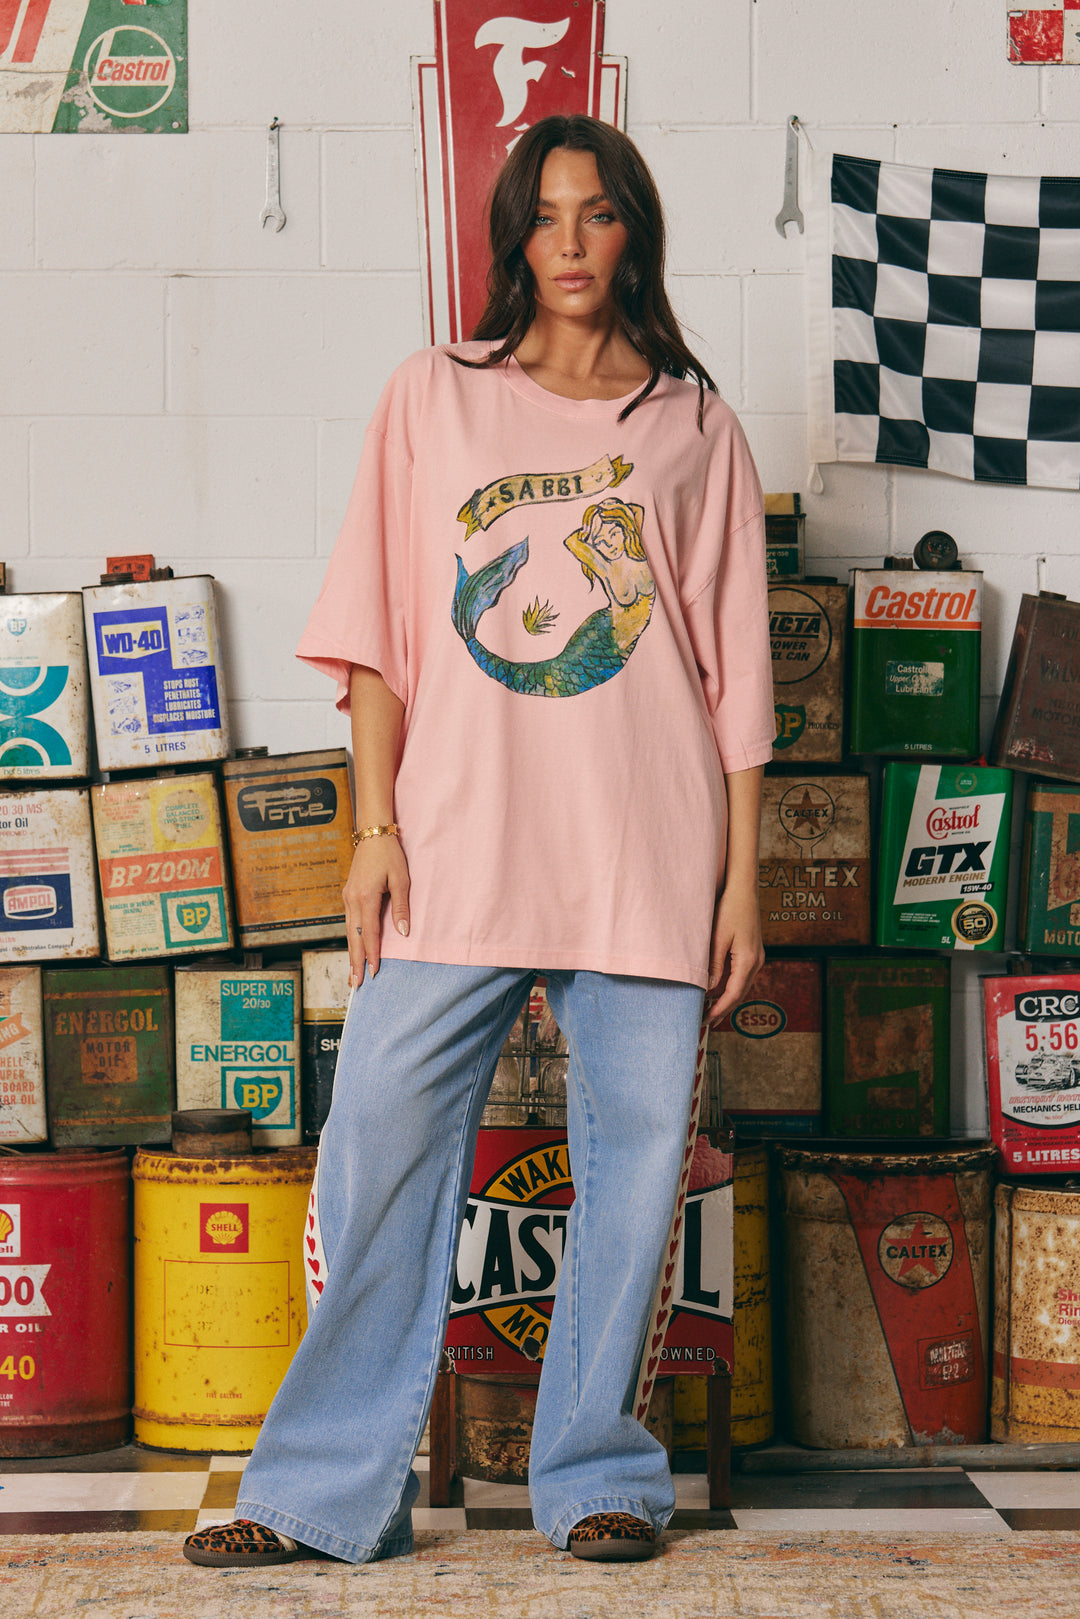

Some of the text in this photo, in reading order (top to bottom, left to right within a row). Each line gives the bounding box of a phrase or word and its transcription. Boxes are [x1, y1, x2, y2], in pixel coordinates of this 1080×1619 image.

[97, 59, 170, 82] Castrol
[499, 475, 583, 503] SABBI
[864, 585, 977, 621] Castrol
[786, 651, 810, 661] CAN
[163, 678, 199, 690] STOPS RUST
[164, 689, 201, 700] PENETRATES
[165, 699, 202, 711] LUBRICATES
[153, 709, 216, 723] DISPLACES MOISTURE
[145, 741, 186, 753] 5 LITRES
[11, 805, 23, 815] 30
[26, 804, 43, 814] MS
[785, 808, 829, 818] CALTEX
[15, 817, 29, 828] Oil
[926, 805, 981, 840] Castrol
[905, 841, 992, 877] GTX
[108, 856, 214, 889] BP ZOOM
[759, 866, 860, 888] CALTEX
[903, 871, 986, 888] MODERN ENGINE
[962, 883, 992, 893] 15W-40
[8, 893, 54, 911] AMPOL
[781, 891, 826, 908] RPM
[181, 907, 208, 927] BP
[768, 911, 844, 921] MOTOR OIL
[963, 918, 987, 930] 50
[941, 936, 951, 944] 5L
[222, 982, 293, 996] SUPER MS
[242, 997, 271, 1009] 20/30
[1019, 994, 1080, 1017] CRC
[56, 1008, 158, 1035] ENERGOL
[86, 1041, 130, 1054] MOTOR
[190, 1044, 295, 1062] ENERGOL
[99, 1055, 119, 1067] OIL
[21, 1094, 37, 1105] OIL
[241, 1084, 279, 1108] BP
[1013, 1104, 1061, 1113] MECHANICS
[1013, 1148, 1080, 1162] 5 LITRES
[499, 1146, 572, 1199] WAK
[210, 1223, 238, 1232] SHELL
[886, 1244, 947, 1259] CALTEX
[1059, 1288, 1080, 1301] Sh
[15, 1323, 42, 1333] OIL
[443, 1346, 716, 1361] RITISH OWNED
[0, 1355, 35, 1380] 40
